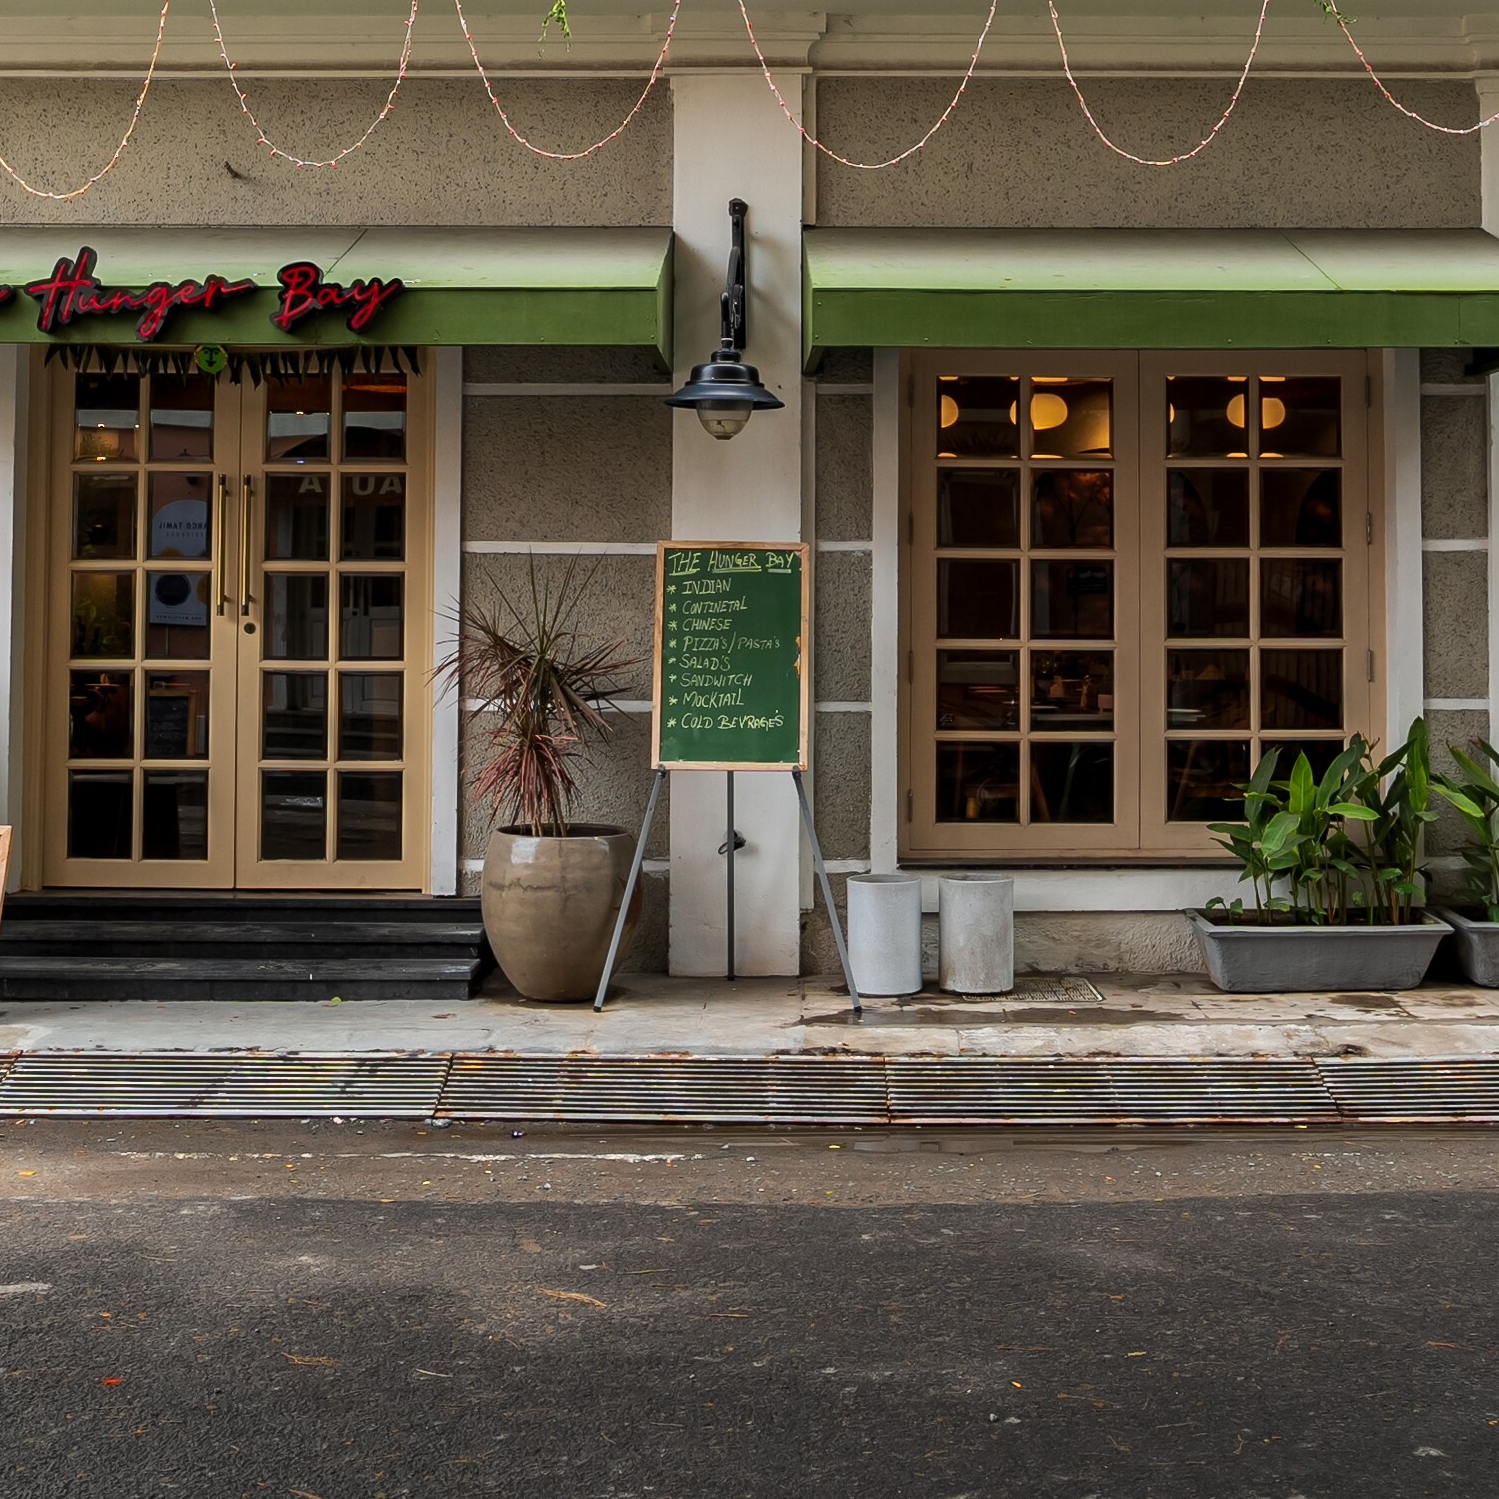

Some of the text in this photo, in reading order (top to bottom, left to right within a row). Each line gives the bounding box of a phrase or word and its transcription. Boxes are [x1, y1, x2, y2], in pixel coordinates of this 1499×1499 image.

[25, 246, 256, 342] Hunger
[268, 260, 406, 334] Bay
[668, 551, 795, 573] THE HUNGER BAY
[681, 578, 732, 595] INDIAN
[683, 619, 732, 631] CHINESE
[679, 654, 731, 670] SALAD'S
[680, 674, 752, 687] SANDWITCH
[683, 688, 744, 708] MOCKTAIL
[681, 713, 713, 729] COLD
